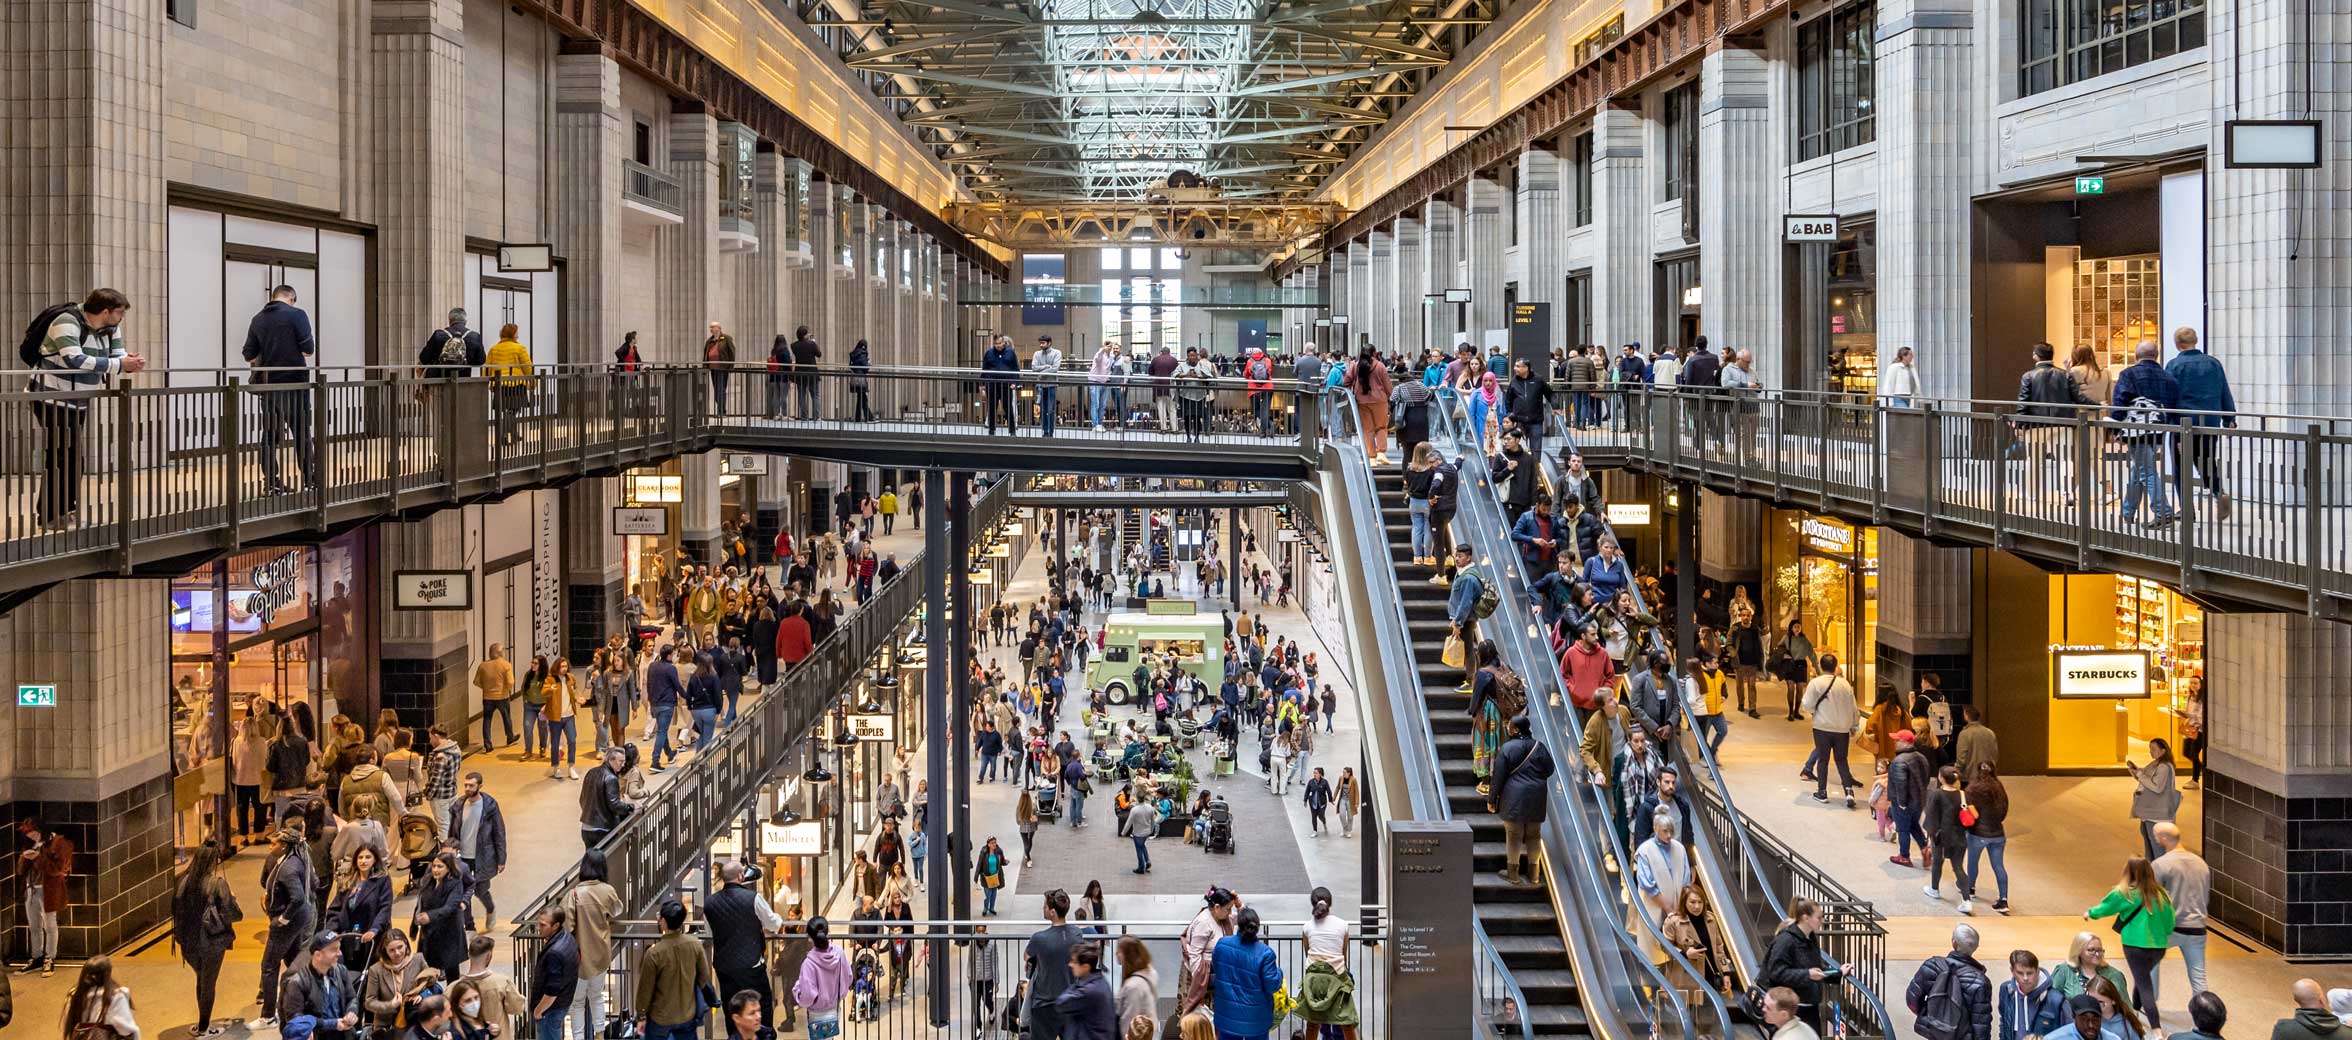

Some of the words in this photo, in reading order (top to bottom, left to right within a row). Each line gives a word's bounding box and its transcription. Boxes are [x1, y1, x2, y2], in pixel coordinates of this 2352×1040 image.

[1804, 223, 1834, 235] BAB
[543, 502, 551, 602] SHOPPING
[429, 578, 447, 590] POKE
[251, 578, 300, 624] HOUSE
[417, 588, 447, 603] HOUSE
[543, 609, 551, 658] YOUR
[2068, 670, 2138, 679] STARBUCKS
[855, 719, 868, 728] THE
[855, 728, 884, 737] KOOPLES
